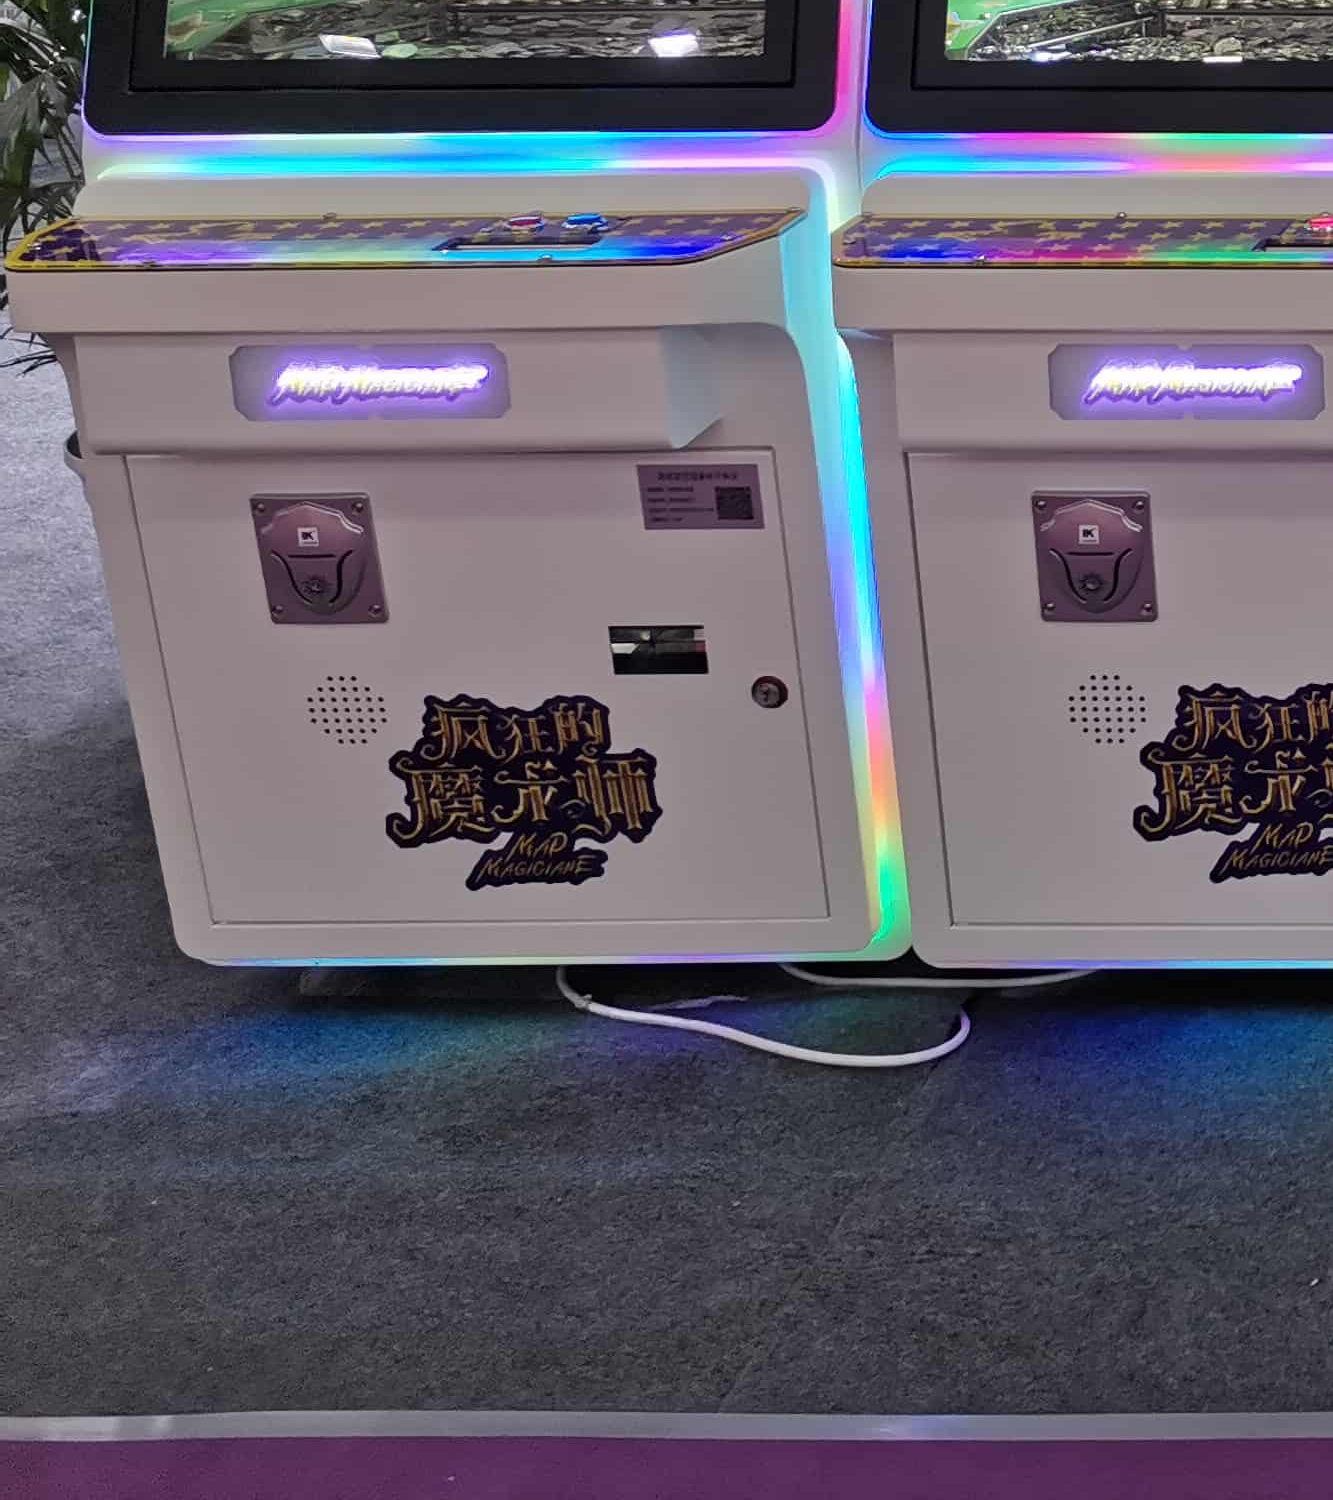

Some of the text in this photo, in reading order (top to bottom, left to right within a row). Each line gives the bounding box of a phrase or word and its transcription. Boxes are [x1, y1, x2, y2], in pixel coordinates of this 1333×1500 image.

[425, 699, 611, 762] 疯狂的
[388, 752, 662, 846] 魔术师
